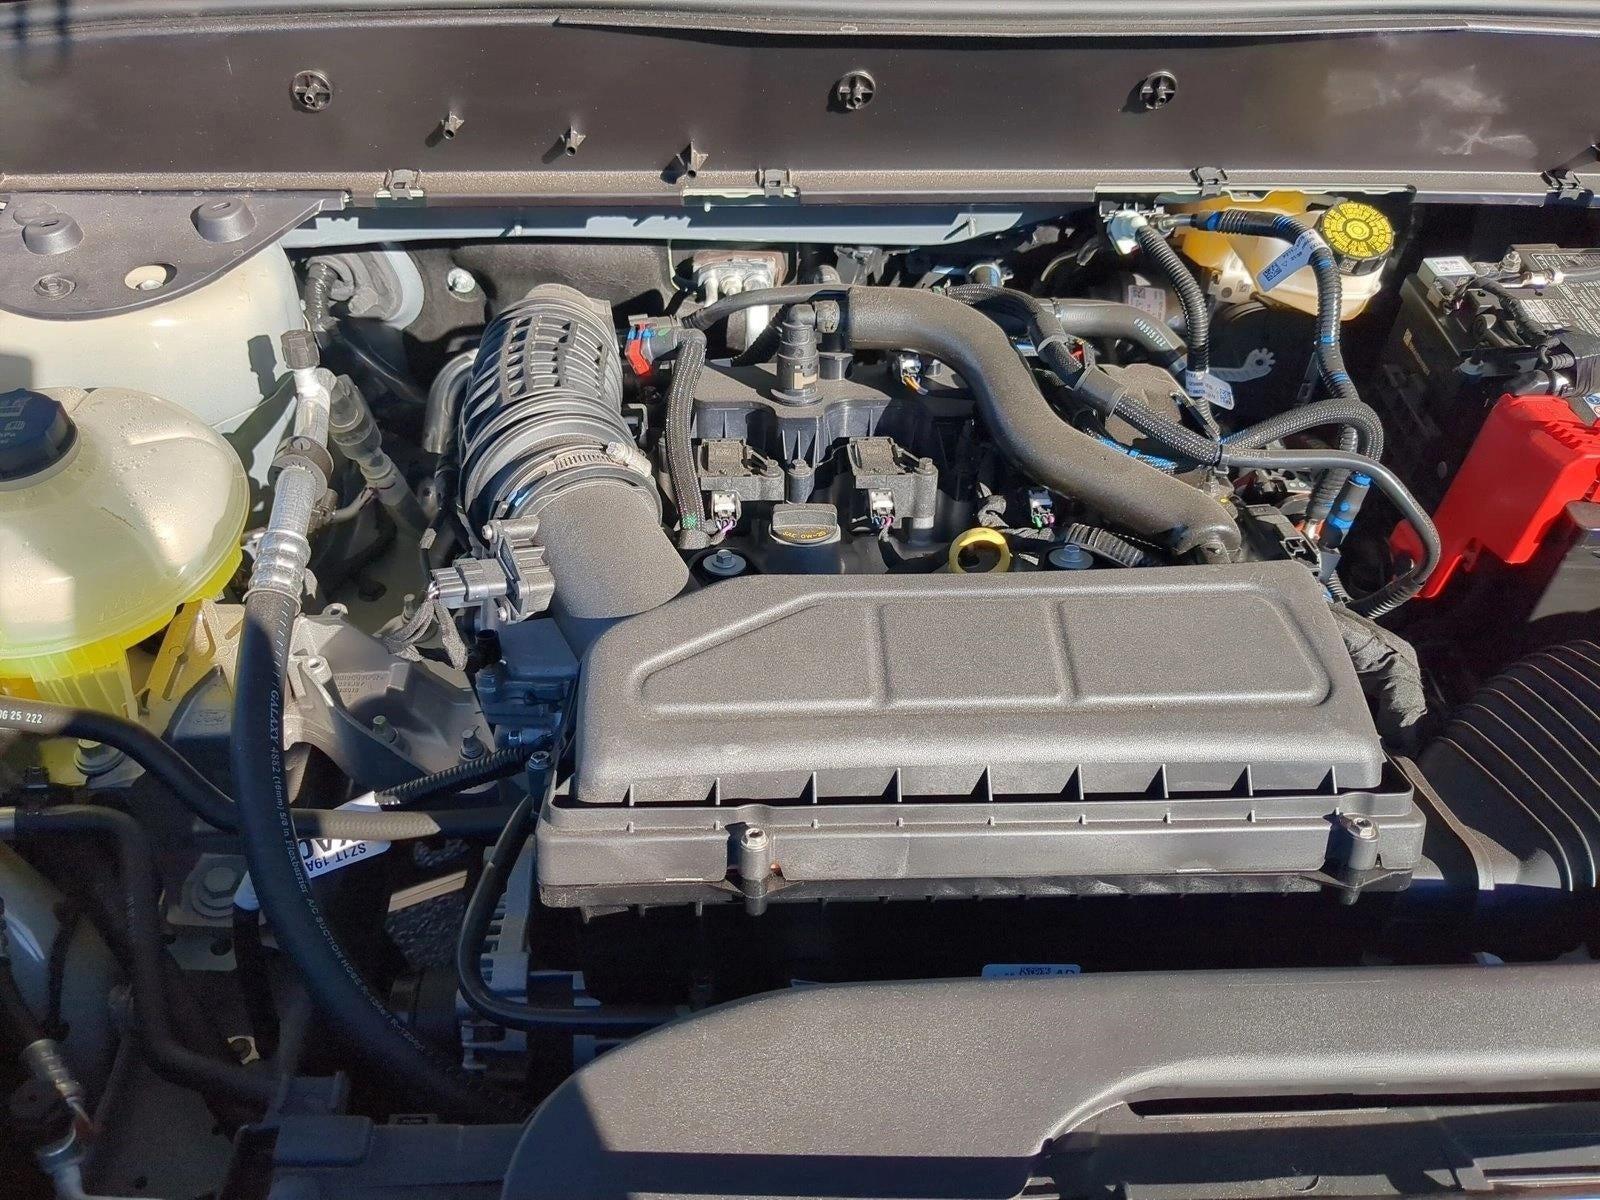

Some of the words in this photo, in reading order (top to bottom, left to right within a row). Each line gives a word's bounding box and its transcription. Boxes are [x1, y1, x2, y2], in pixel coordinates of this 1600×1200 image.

[10, 710, 22, 720] 25
[26, 712, 43, 724] 222
[270, 690, 280, 745] GALAXY
[335, 842, 367, 864] SZ1T
[304, 857, 331, 872] 19A
